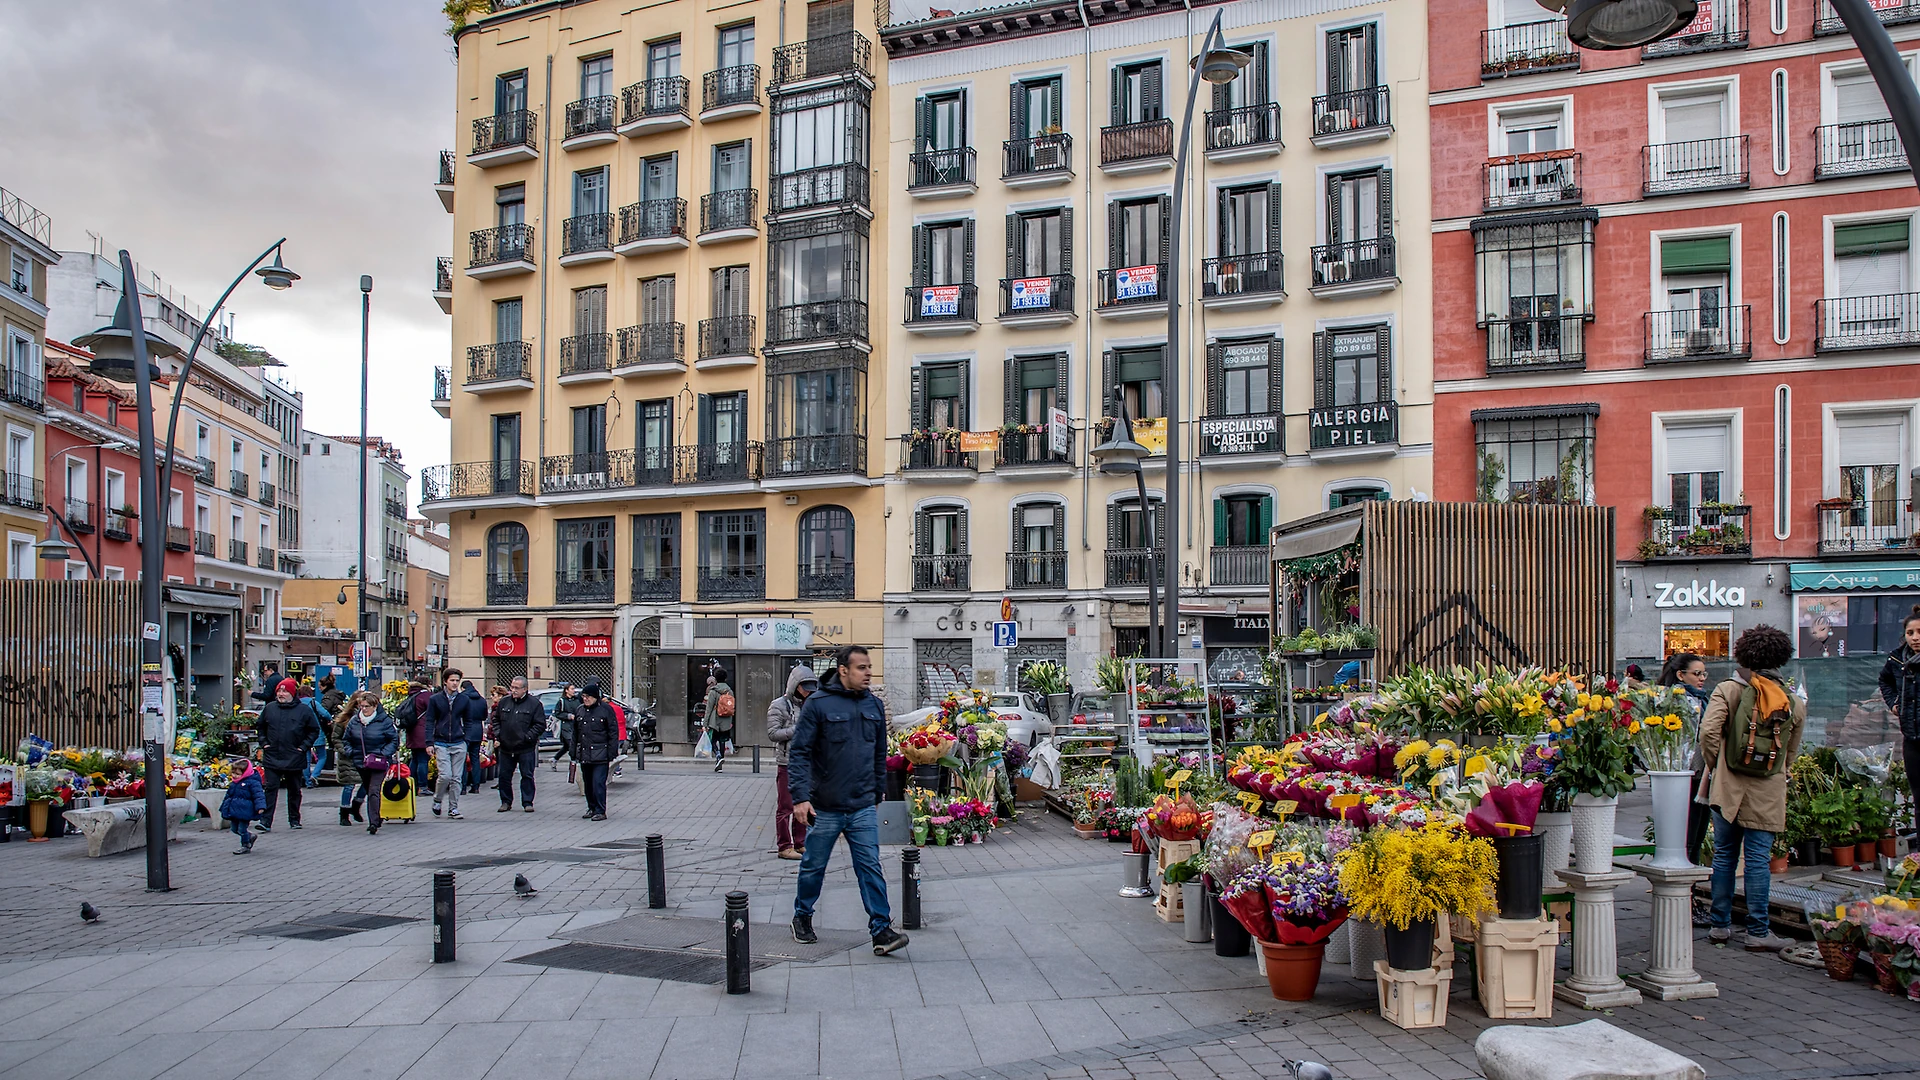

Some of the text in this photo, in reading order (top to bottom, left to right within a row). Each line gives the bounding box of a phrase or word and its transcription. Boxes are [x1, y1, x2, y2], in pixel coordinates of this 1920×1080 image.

[1702, 22, 1712, 31] 07
[1130, 267, 1155, 276] VENDE
[1334, 346, 1349, 354] 620
[1312, 406, 1389, 428] ALERGIA
[1202, 419, 1275, 434] ESPECIALISTA
[1212, 431, 1268, 446] CABELLO
[1331, 429, 1376, 445] PIEL
[1818, 573, 1879, 586] Aqua
[1655, 579, 1745, 608] Zakka
[584, 646, 608, 654] MAYOR
